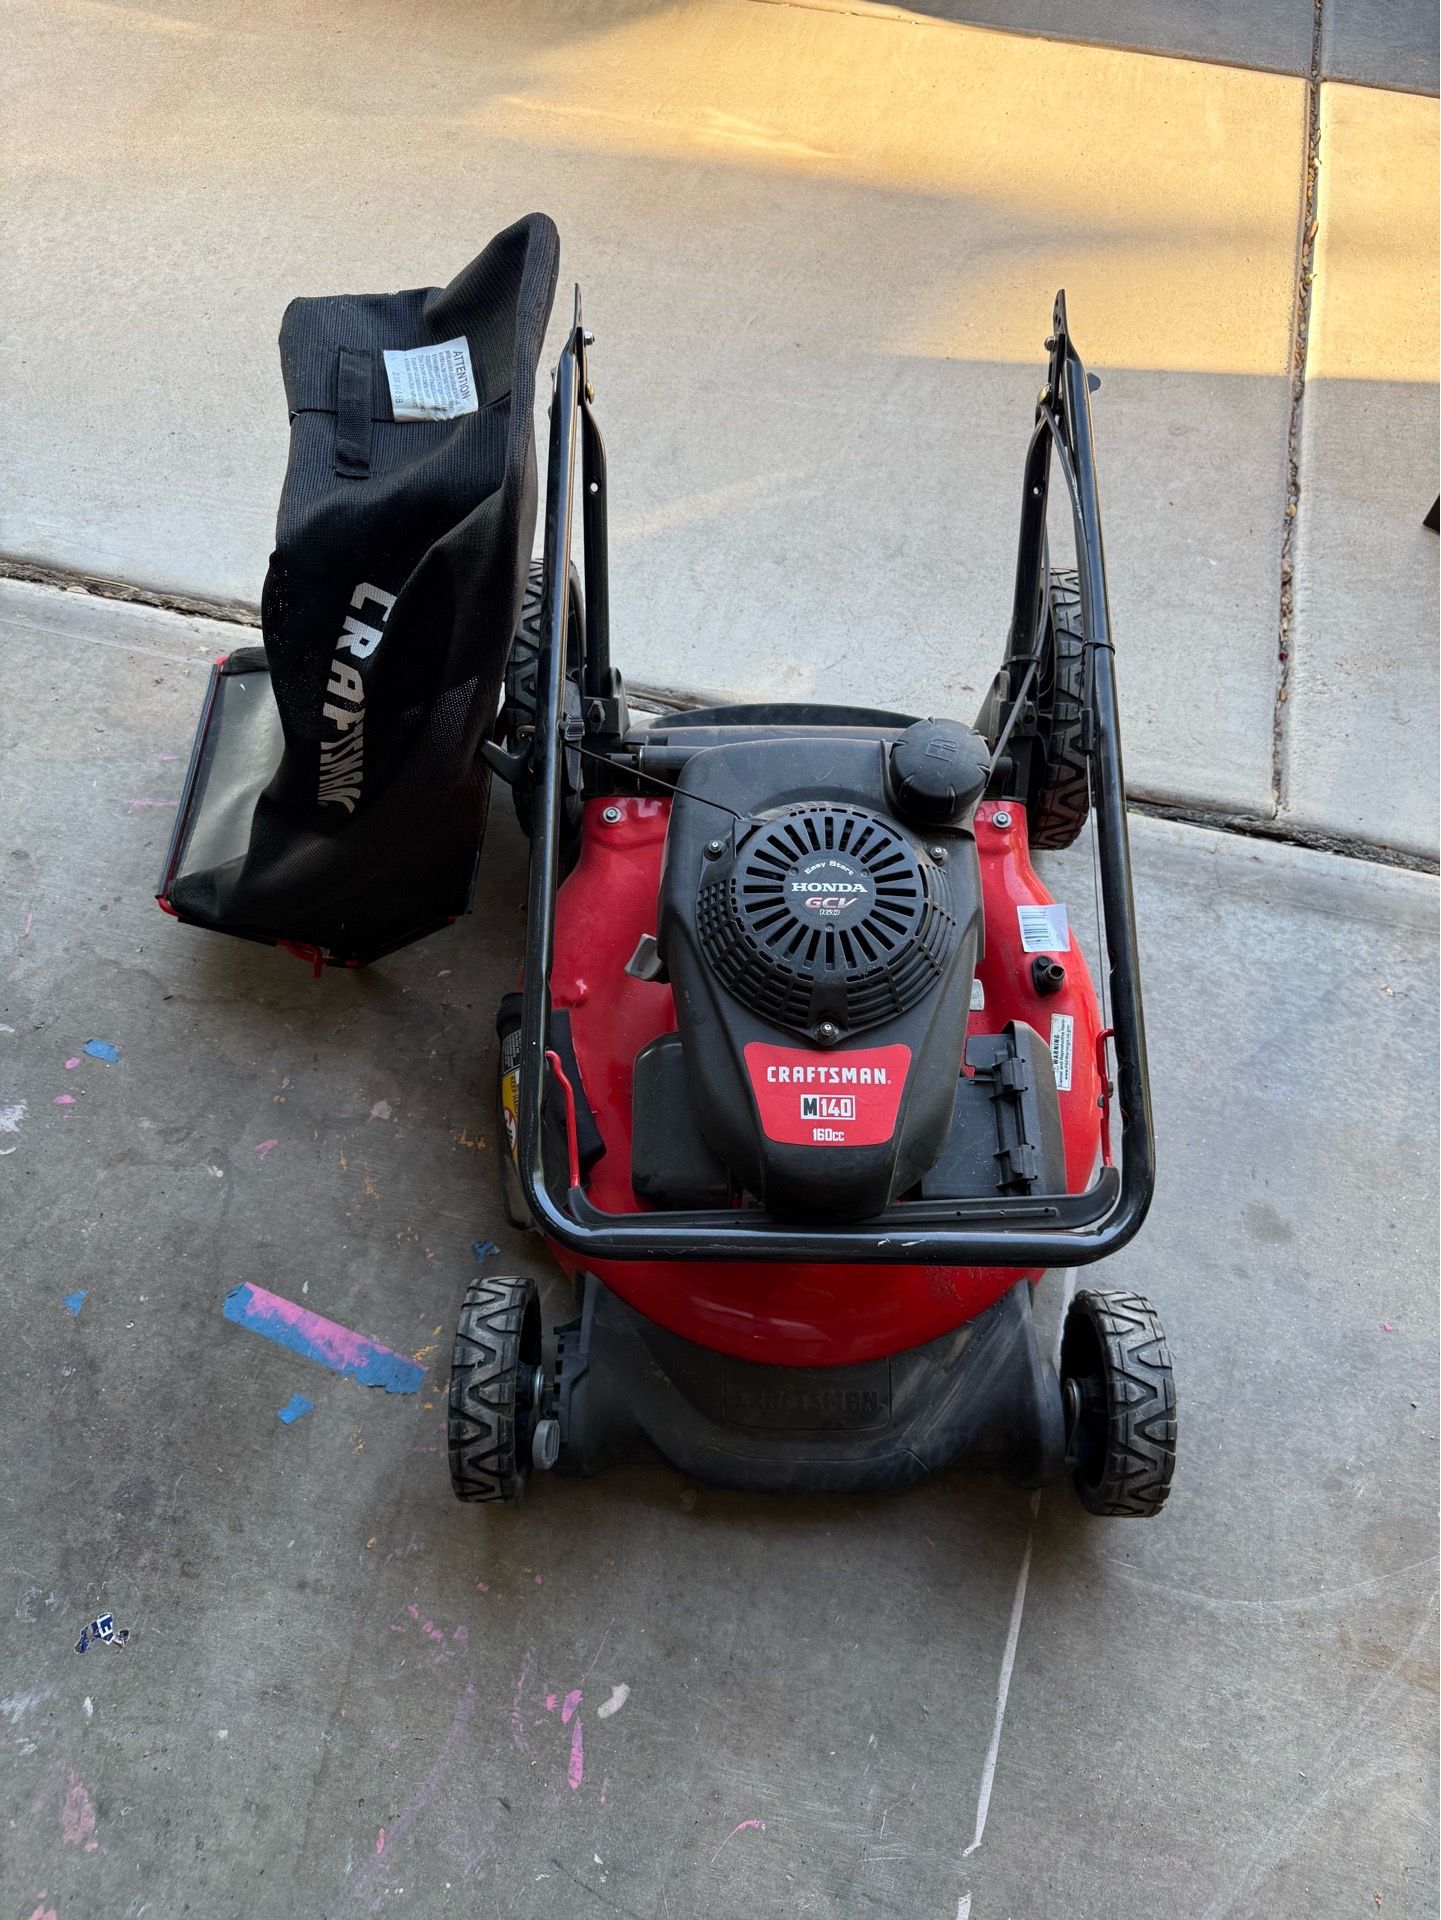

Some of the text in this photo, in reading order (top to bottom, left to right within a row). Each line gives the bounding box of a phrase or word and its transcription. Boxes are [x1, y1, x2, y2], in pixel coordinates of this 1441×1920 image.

[453, 350, 471, 400] ATTENTION
[318, 582, 398, 813] CRAFTSMAN
[804, 860, 854, 876] Easy Start
[791, 882, 868, 893] HONDA
[805, 896, 860, 909] GCV
[767, 1065, 887, 1085] CRAFTSMAN
[803, 1097, 852, 1117] M140
